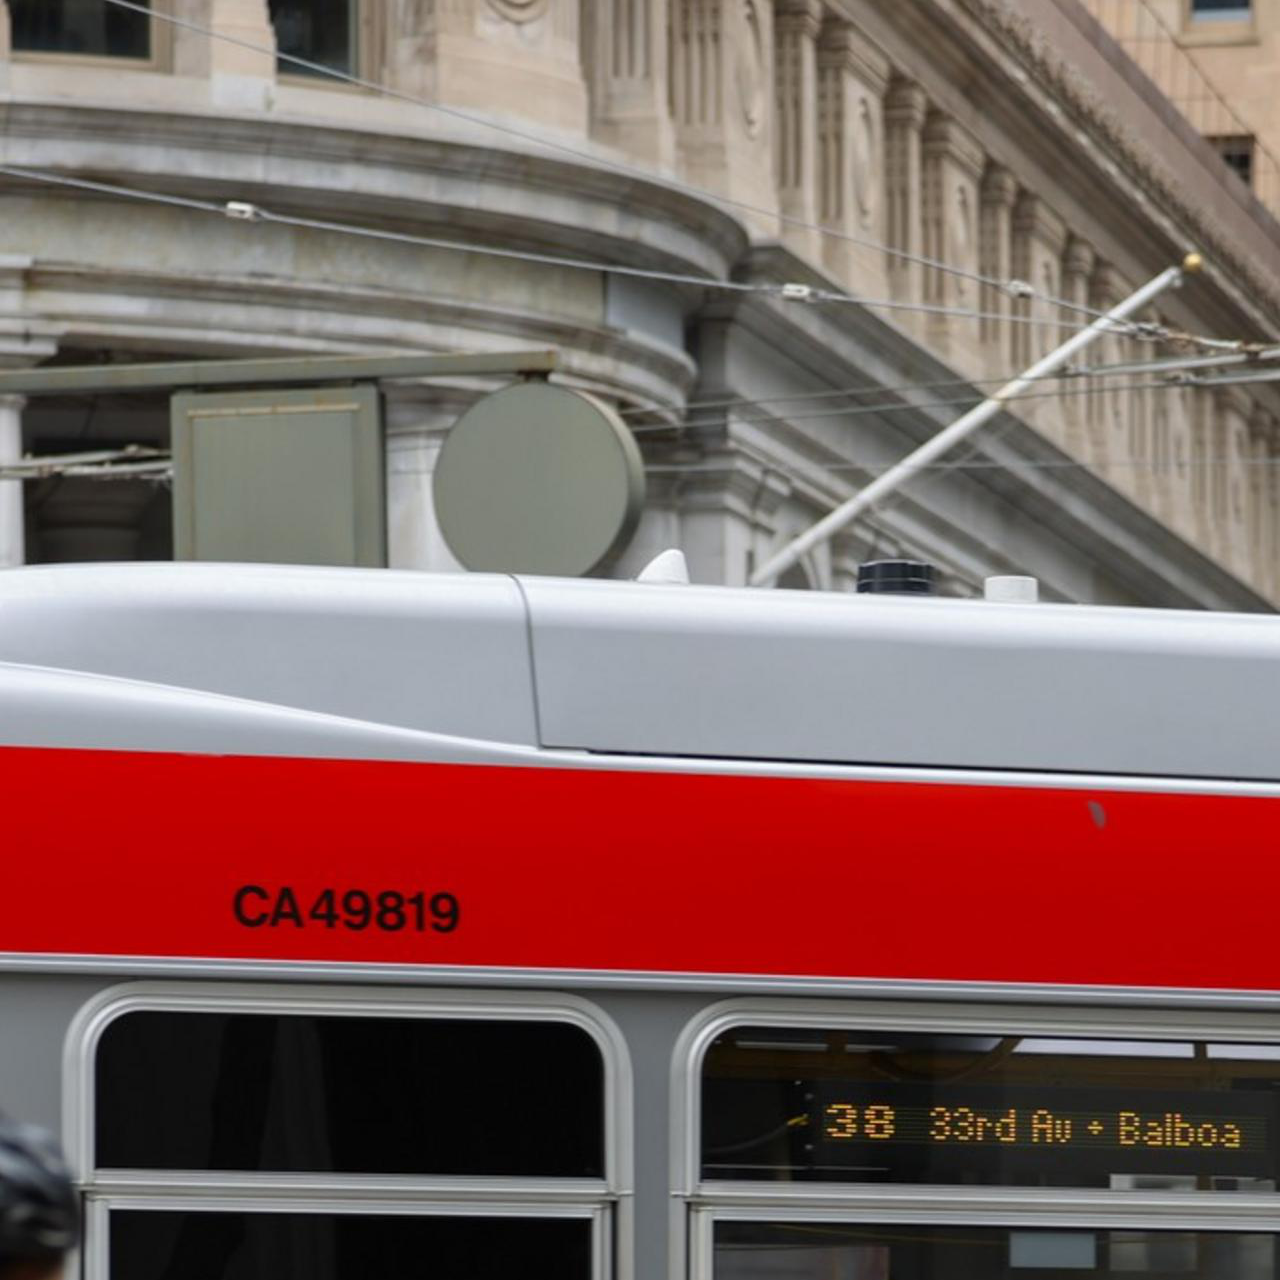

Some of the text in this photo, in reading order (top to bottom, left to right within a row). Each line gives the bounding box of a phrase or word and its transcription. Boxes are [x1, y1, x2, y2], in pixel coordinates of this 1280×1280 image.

[233, 884, 460, 934] CA49819
[826, 1103, 895, 1140] 38
[929, 1106, 1017, 1142] 33rd
[1031, 1109, 1072, 1144] Av
[1119, 1112, 1241, 1148] Balboa
